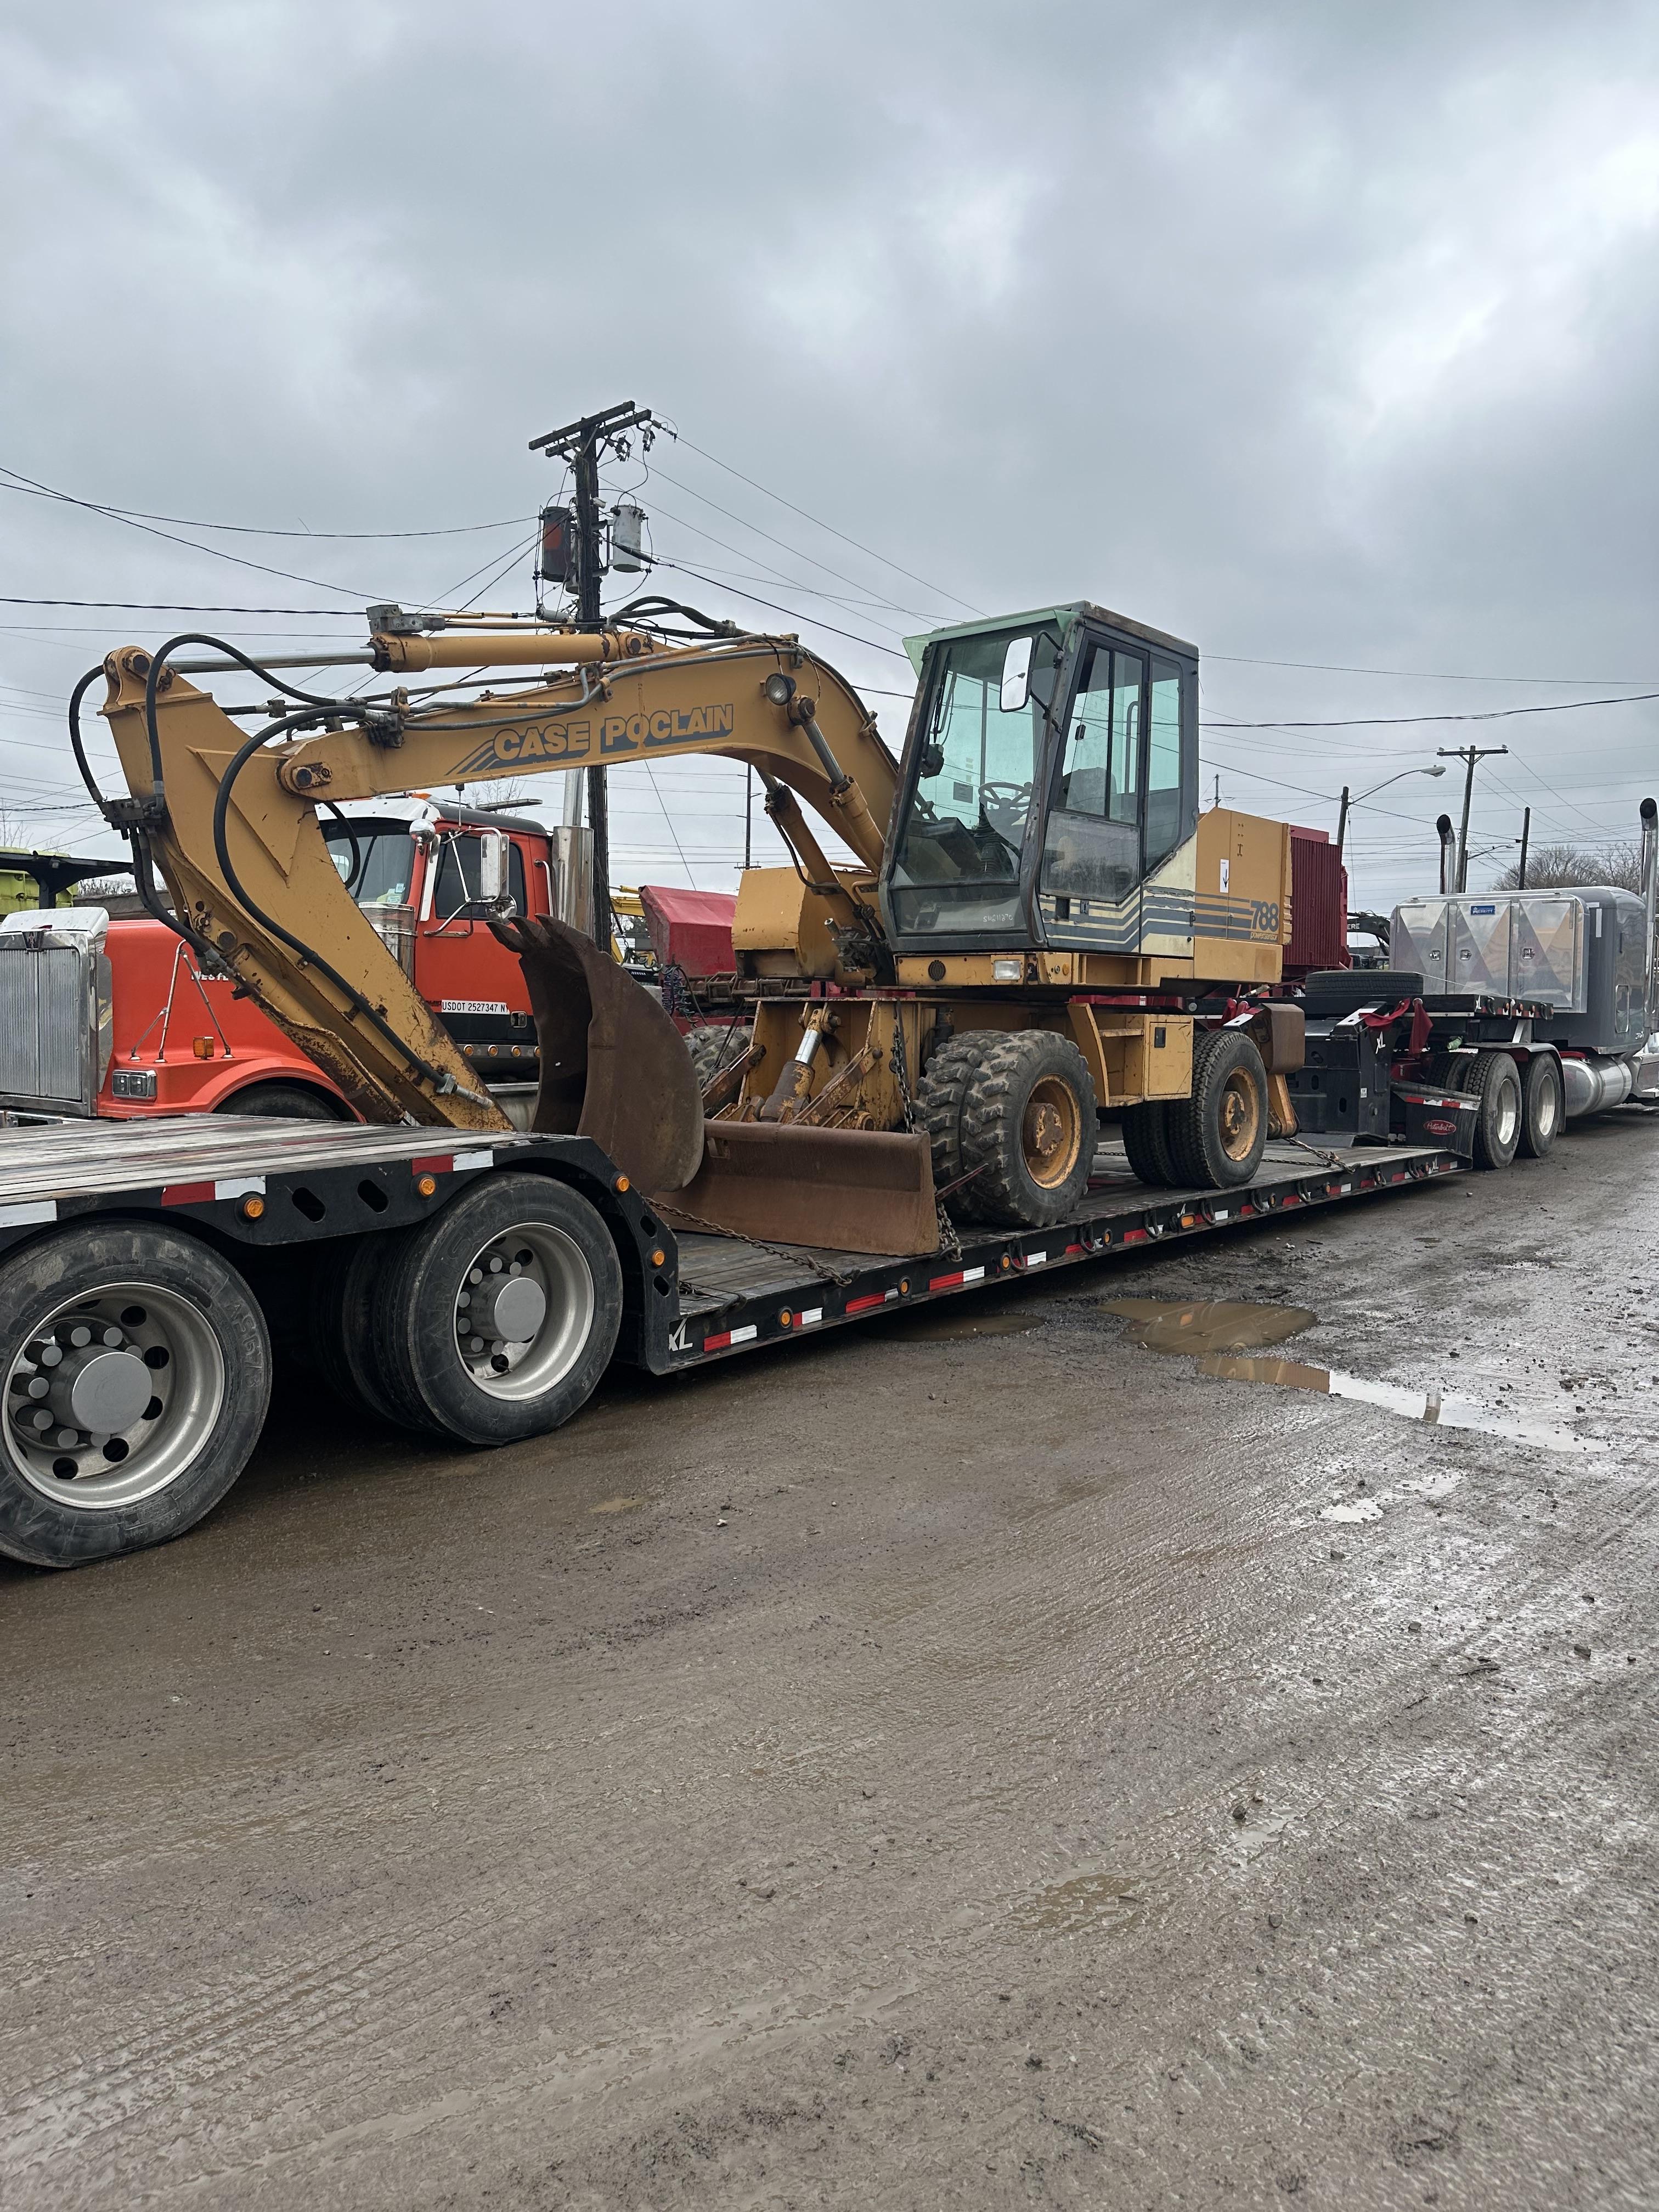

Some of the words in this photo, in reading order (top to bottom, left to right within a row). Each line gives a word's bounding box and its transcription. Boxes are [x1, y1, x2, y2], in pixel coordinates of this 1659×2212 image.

[494, 721, 590, 761] CASE
[603, 704, 734, 748] POCLAIN
[1251, 900, 1279, 932] 788
[442, 1002, 465, 1011] USDOT
[468, 1002, 498, 1012] 2527347
[1427, 1122, 1454, 1131] Peterbilt
[668, 1317, 693, 1352] XL
